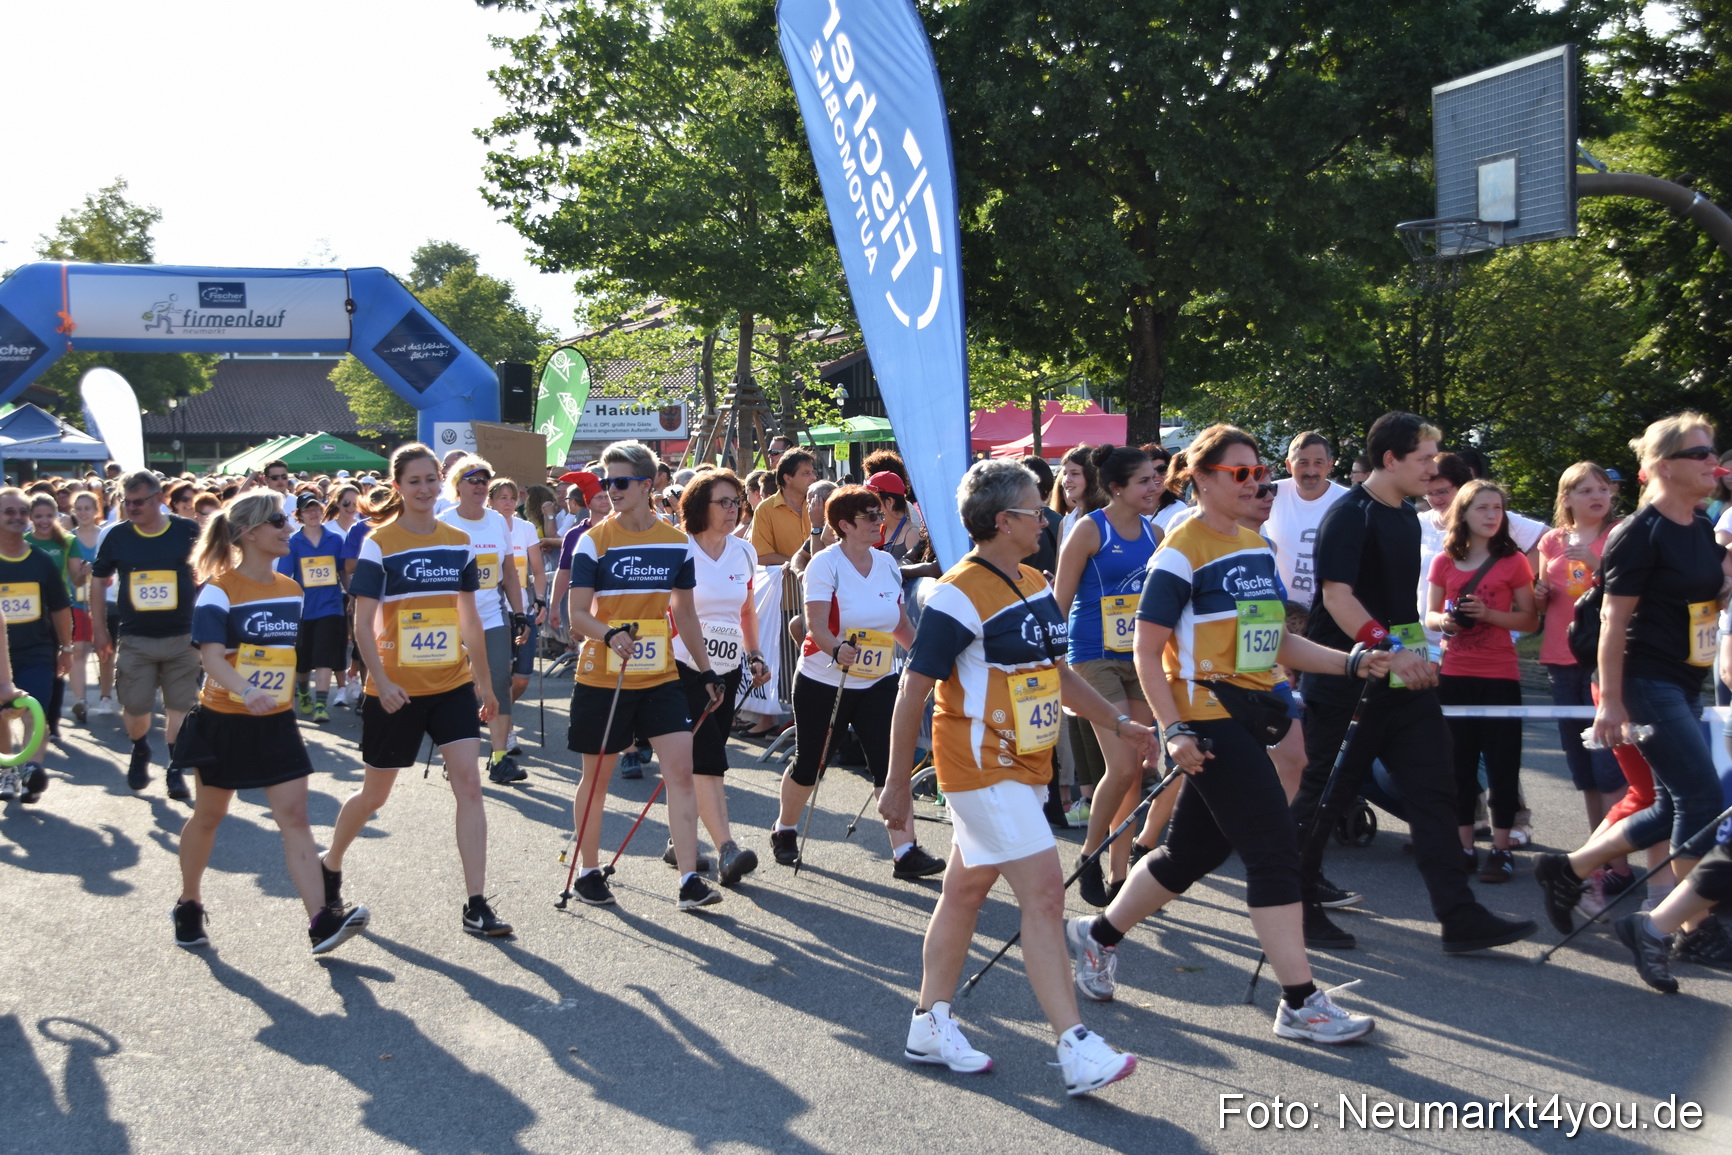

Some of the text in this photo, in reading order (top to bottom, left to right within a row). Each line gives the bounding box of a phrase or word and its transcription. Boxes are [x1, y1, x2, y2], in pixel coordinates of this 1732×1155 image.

[208, 290, 244, 300] Fischer
[183, 309, 287, 328] firmenlauf
[391, 344, 406, 353] und
[408, 342, 422, 351] das
[309, 567, 330, 578] 793
[415, 565, 460, 578] Fischer
[623, 565, 670, 576] Fischer
[140, 586, 169, 600] 835
[2, 598, 31, 612] 834
[410, 631, 448, 650] 442
[1243, 629, 1279, 652] 1520
[855, 649, 882, 667] 161
[247, 669, 285, 690] 422
[1030, 699, 1059, 729] 439
